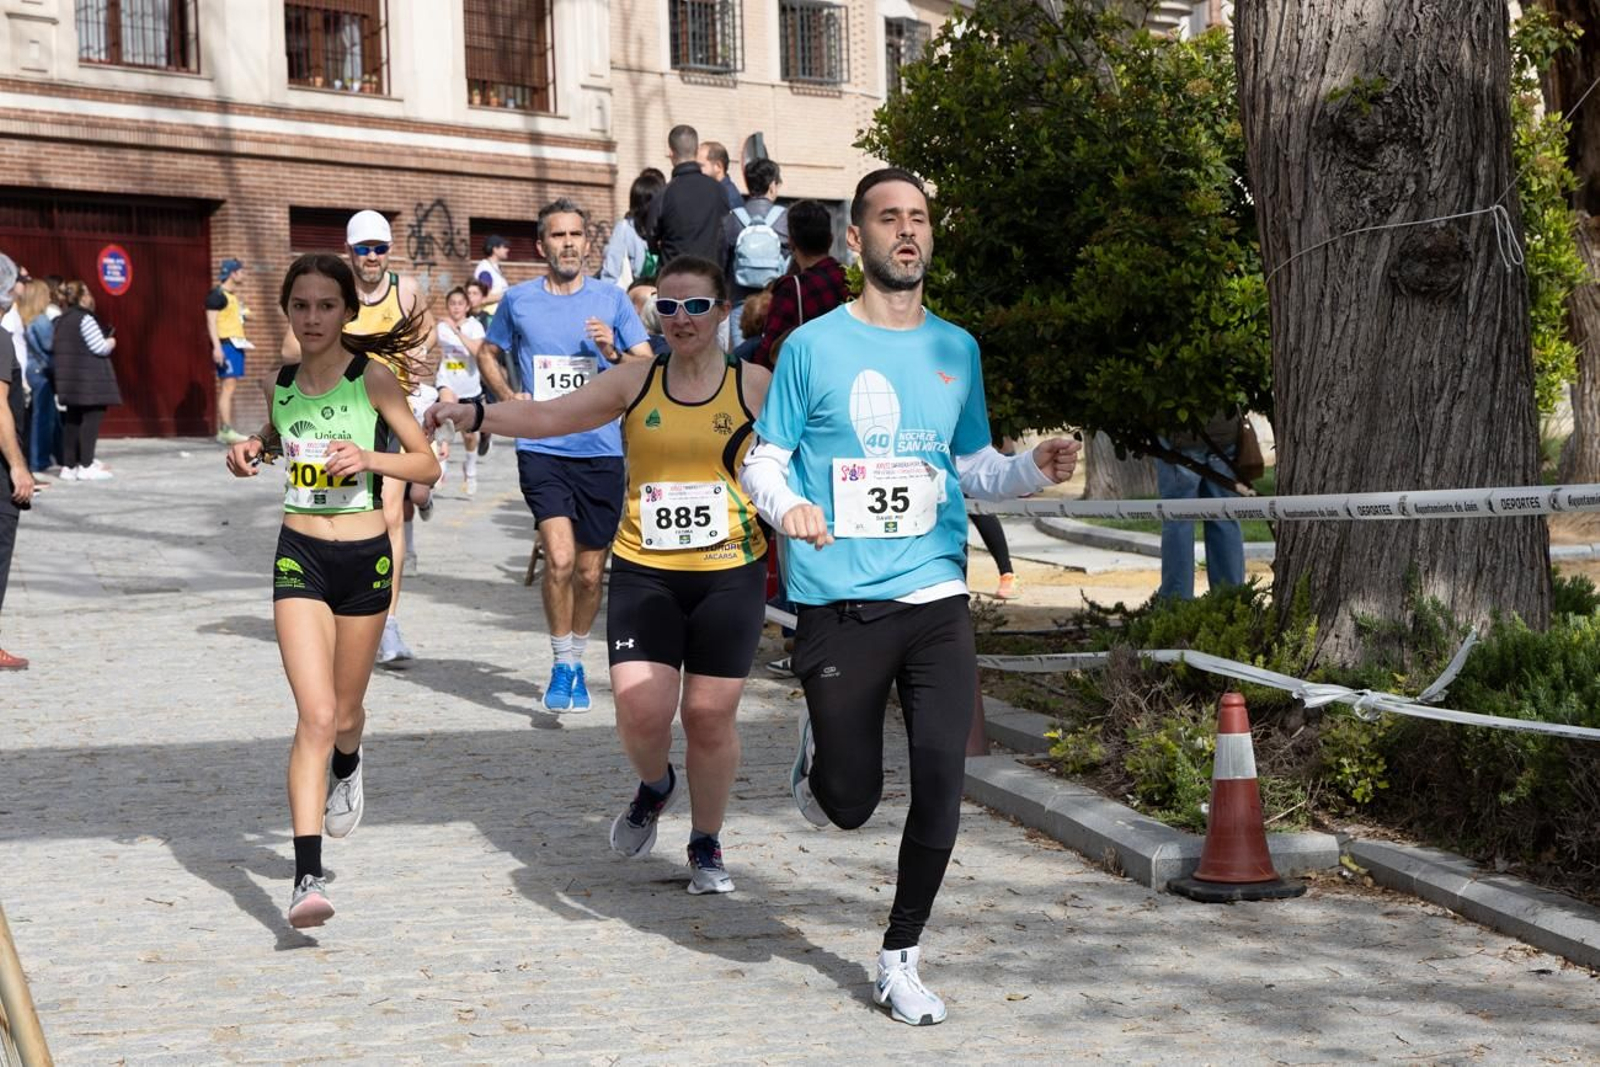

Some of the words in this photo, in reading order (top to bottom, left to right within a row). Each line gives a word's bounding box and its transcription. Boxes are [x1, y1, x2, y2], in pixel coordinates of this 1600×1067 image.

[547, 373, 584, 389] 150
[866, 432, 889, 449] 40
[897, 441, 921, 453] SAN
[867, 486, 910, 514] 35
[1357, 504, 1392, 516] DEPORTES
[1500, 496, 1541, 510] DEPORTES
[655, 505, 711, 530] 885
[704, 553, 737, 561] JACARSA
